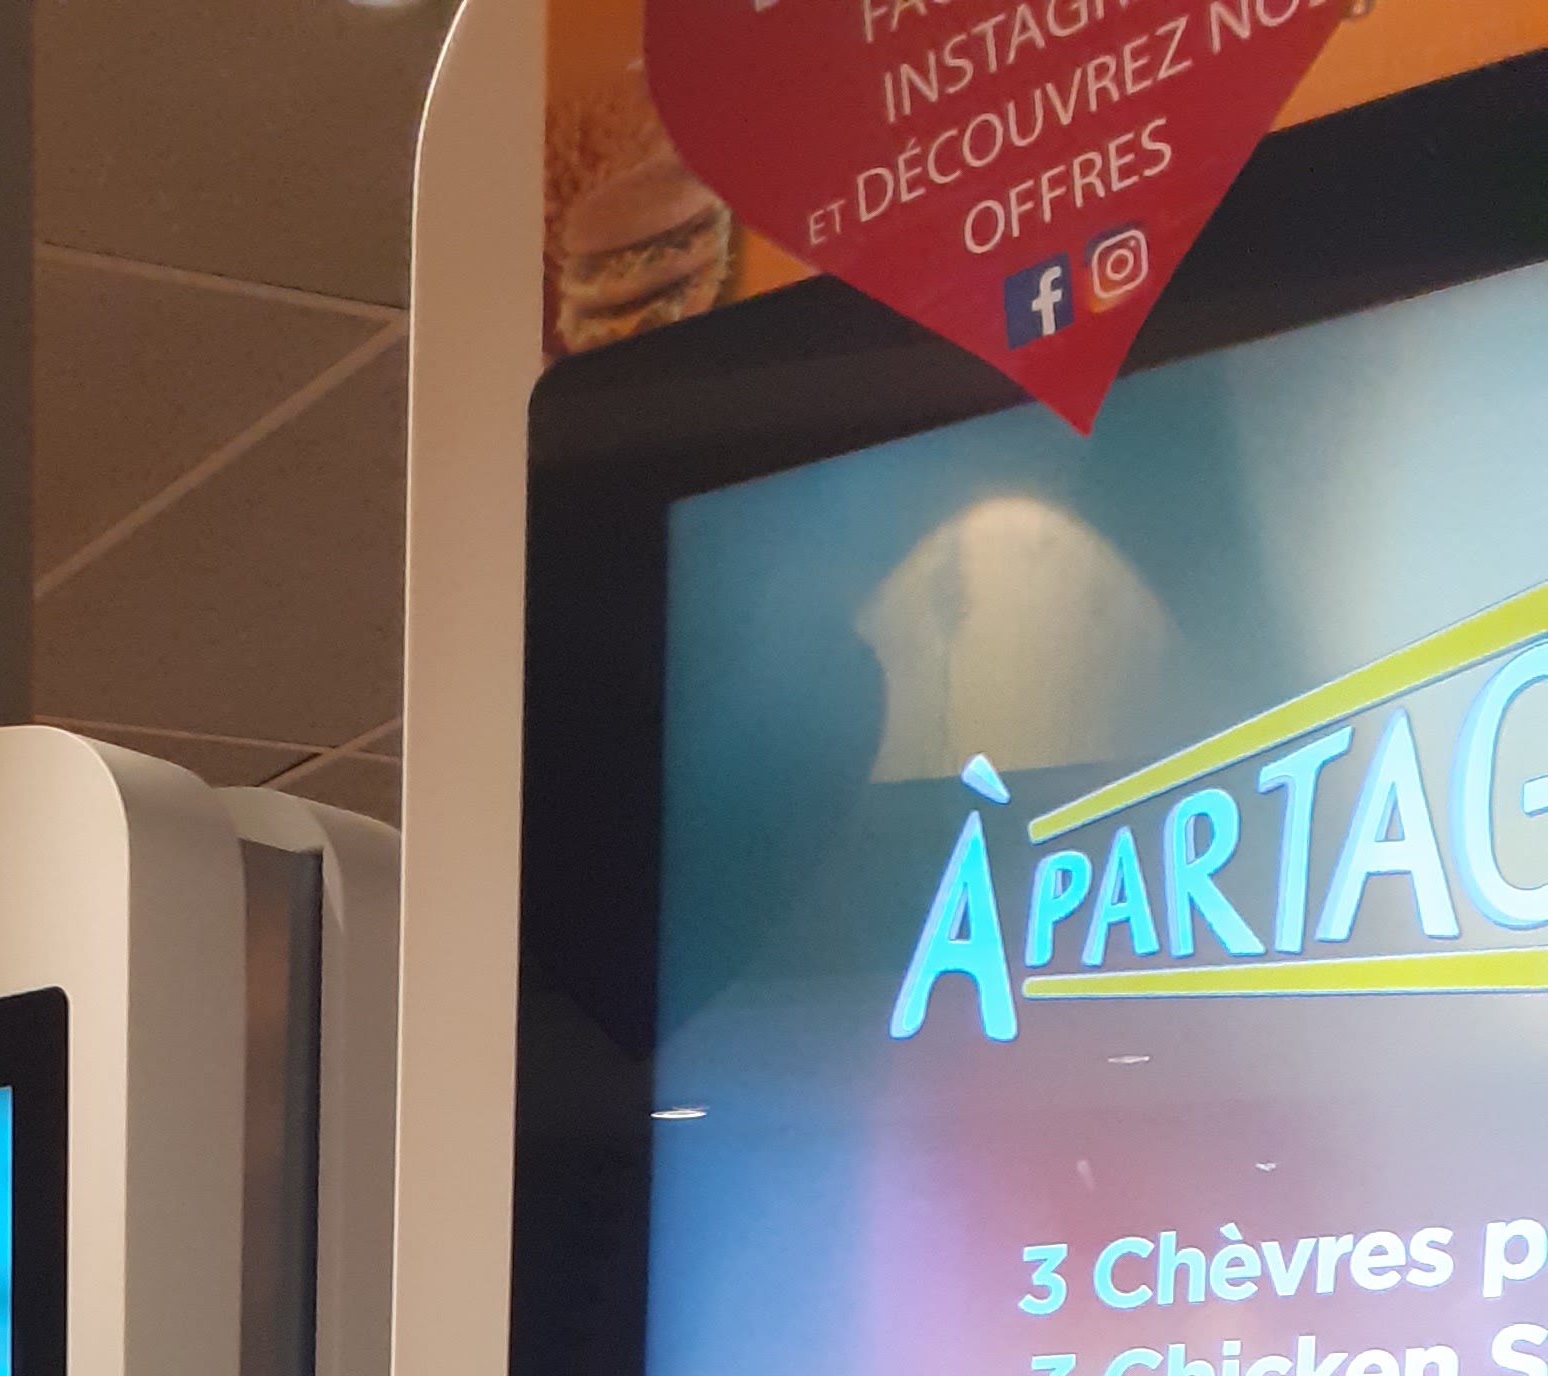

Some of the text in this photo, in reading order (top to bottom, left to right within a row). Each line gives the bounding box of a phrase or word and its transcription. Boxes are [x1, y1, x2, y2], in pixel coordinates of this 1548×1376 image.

[808, 199, 847, 246] ET
[856, 14, 1193, 222] DÉCOUVREZ
[963, 117, 1172, 254] OFFRES
[889, 753, 1018, 1042] À
[1018, 1243, 1068, 1315] 3
[1093, 1223, 1453, 1309] Chèvres
